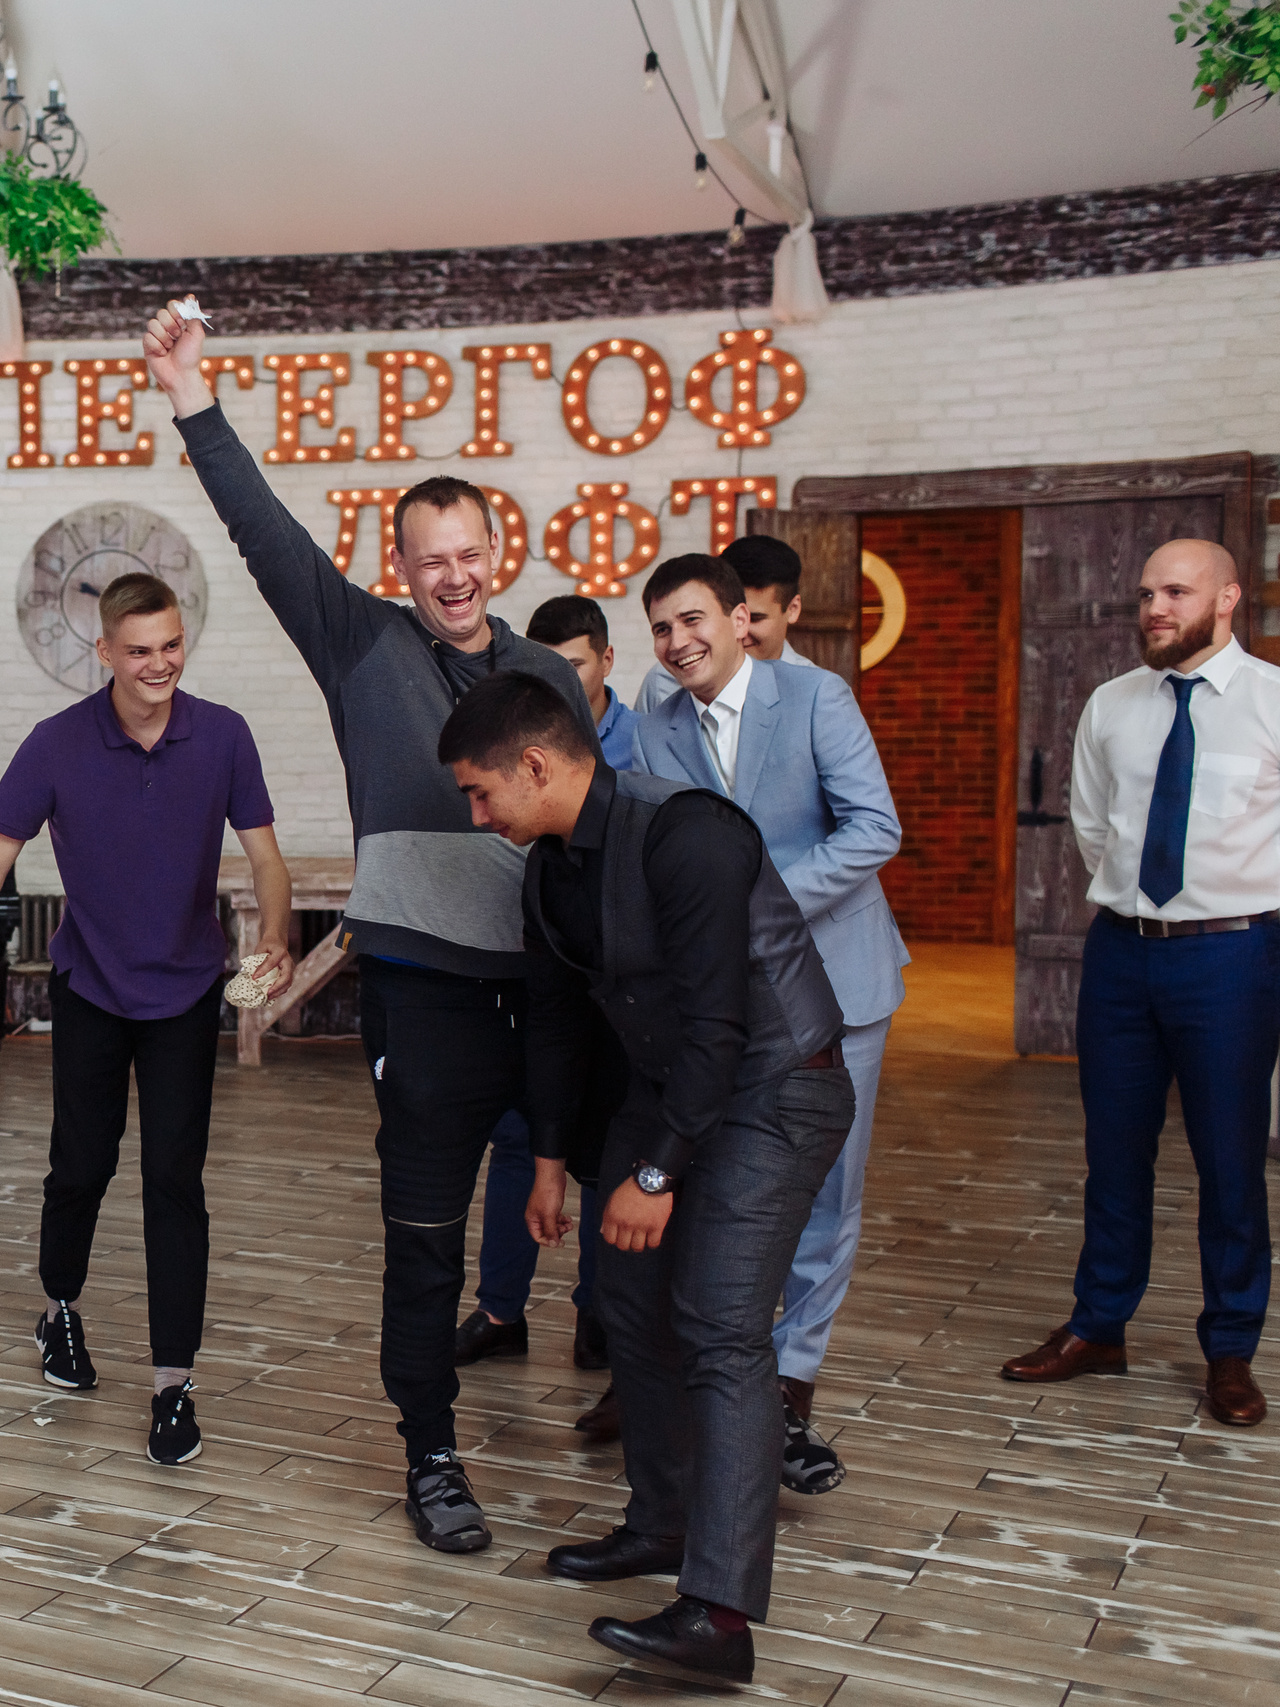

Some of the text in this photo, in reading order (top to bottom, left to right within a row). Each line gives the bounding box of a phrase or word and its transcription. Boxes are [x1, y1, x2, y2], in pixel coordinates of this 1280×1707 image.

[64, 523, 89, 554] 11
[100, 512, 125, 547] 12
[154, 551, 190, 579] 2
[35, 622, 67, 647] 8
